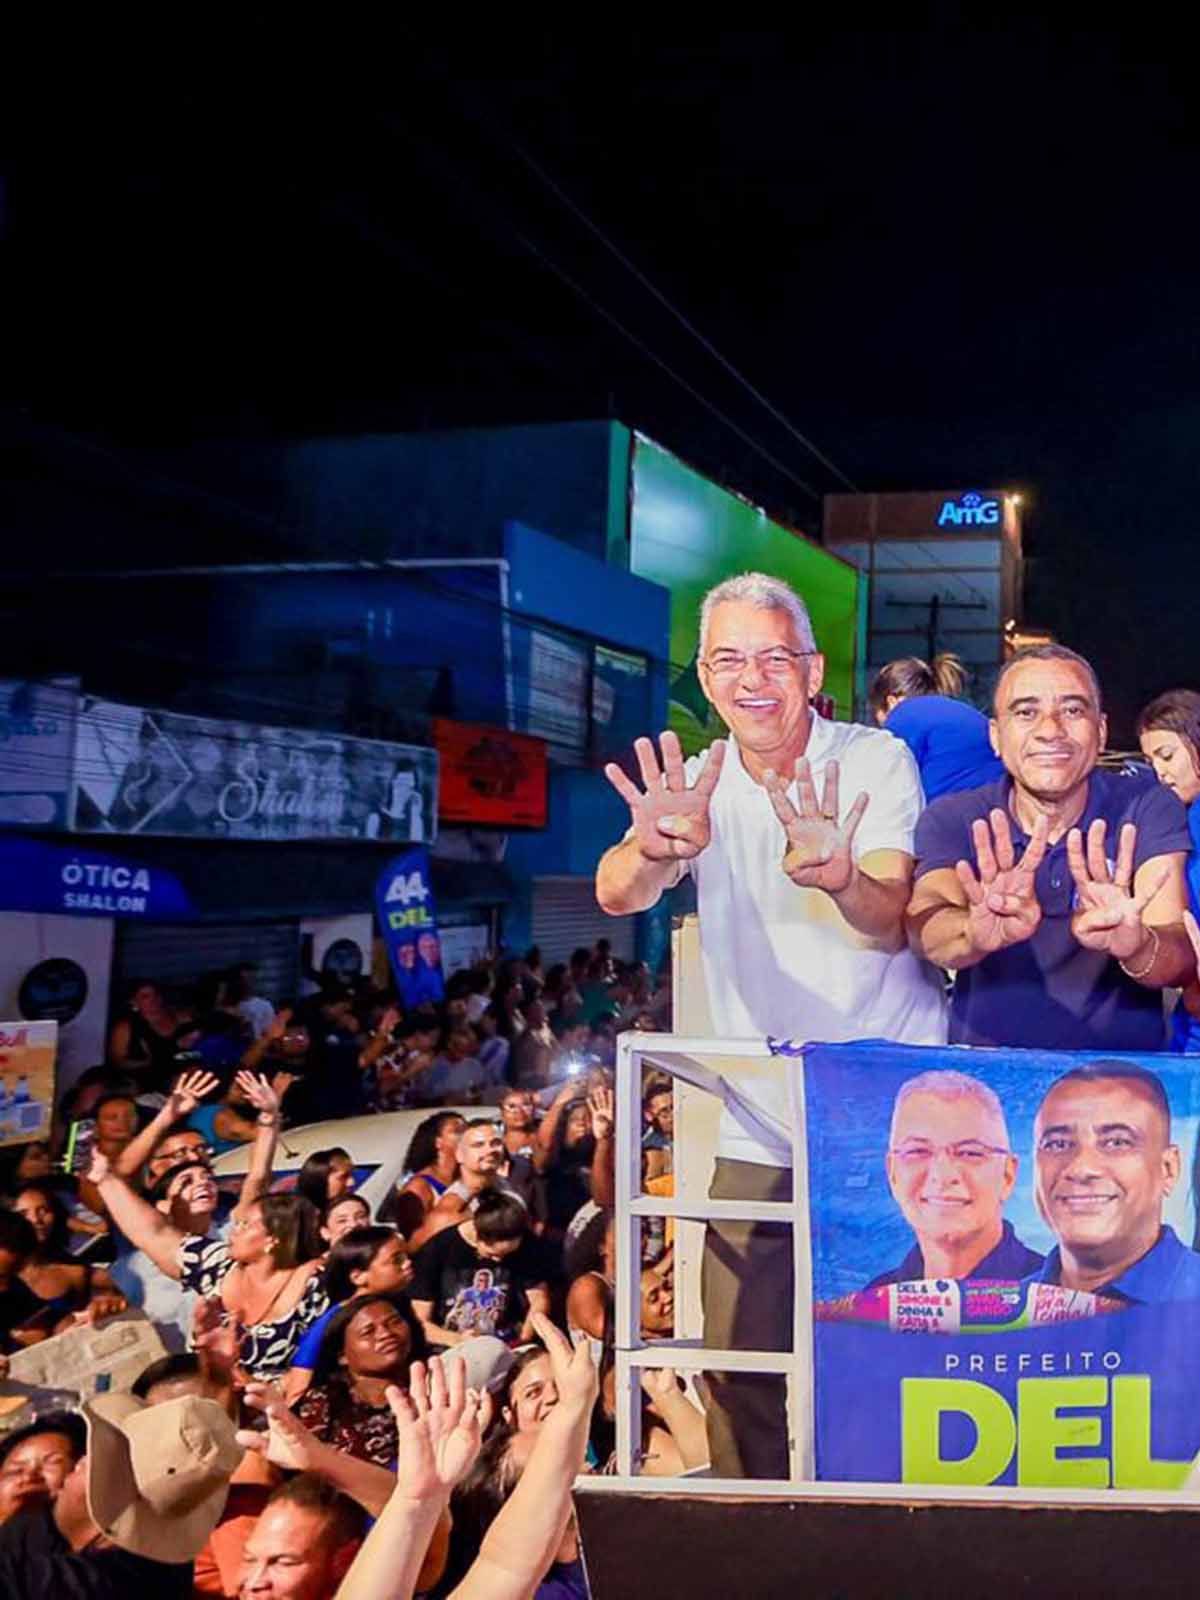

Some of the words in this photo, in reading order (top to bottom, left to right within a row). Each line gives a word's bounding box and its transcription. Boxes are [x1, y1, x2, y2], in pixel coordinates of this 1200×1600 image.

[61, 858, 150, 892] ÓTICA
[385, 872, 430, 905] 44
[388, 907, 434, 930] DEL
[945, 1351, 1122, 1373] PREFEITO
[901, 1376, 1194, 1488] DEL
